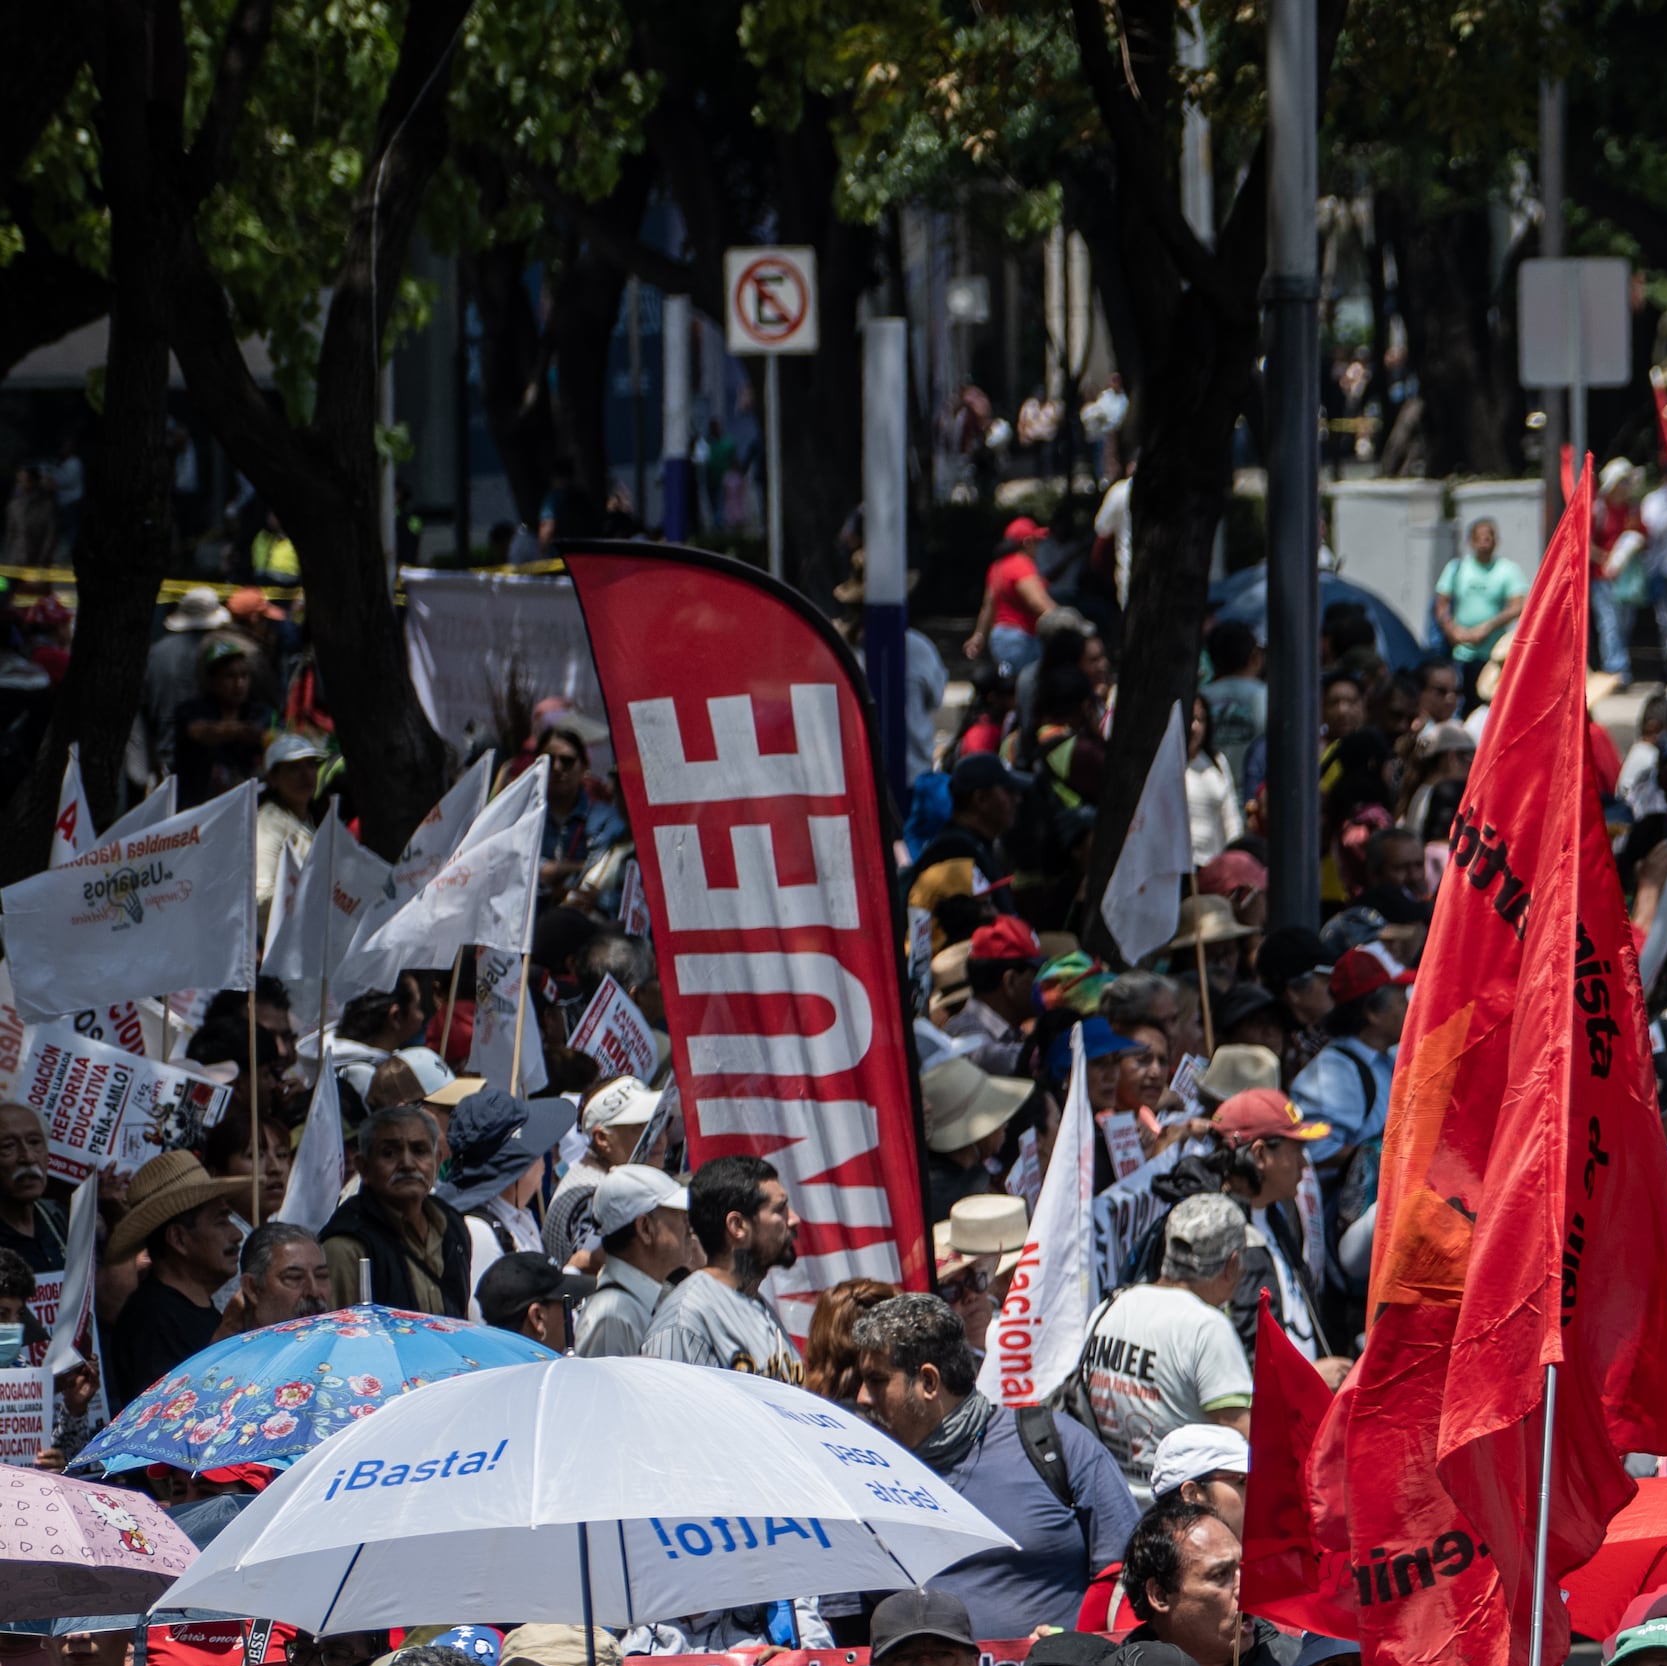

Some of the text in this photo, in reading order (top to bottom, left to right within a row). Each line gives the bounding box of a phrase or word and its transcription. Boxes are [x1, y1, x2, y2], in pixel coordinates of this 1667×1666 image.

[28, 1044, 61, 1110] OGACIÓN
[51, 1056, 90, 1144] REFORMA
[68, 1063, 110, 1149] EDUCATIVA
[998, 1242, 1042, 1409] Nacional
[807, 1412, 847, 1430] un
[324, 1438, 510, 1501] ¡Basta!
[820, 1440, 891, 1468] paso
[865, 1480, 948, 1513] atrás!
